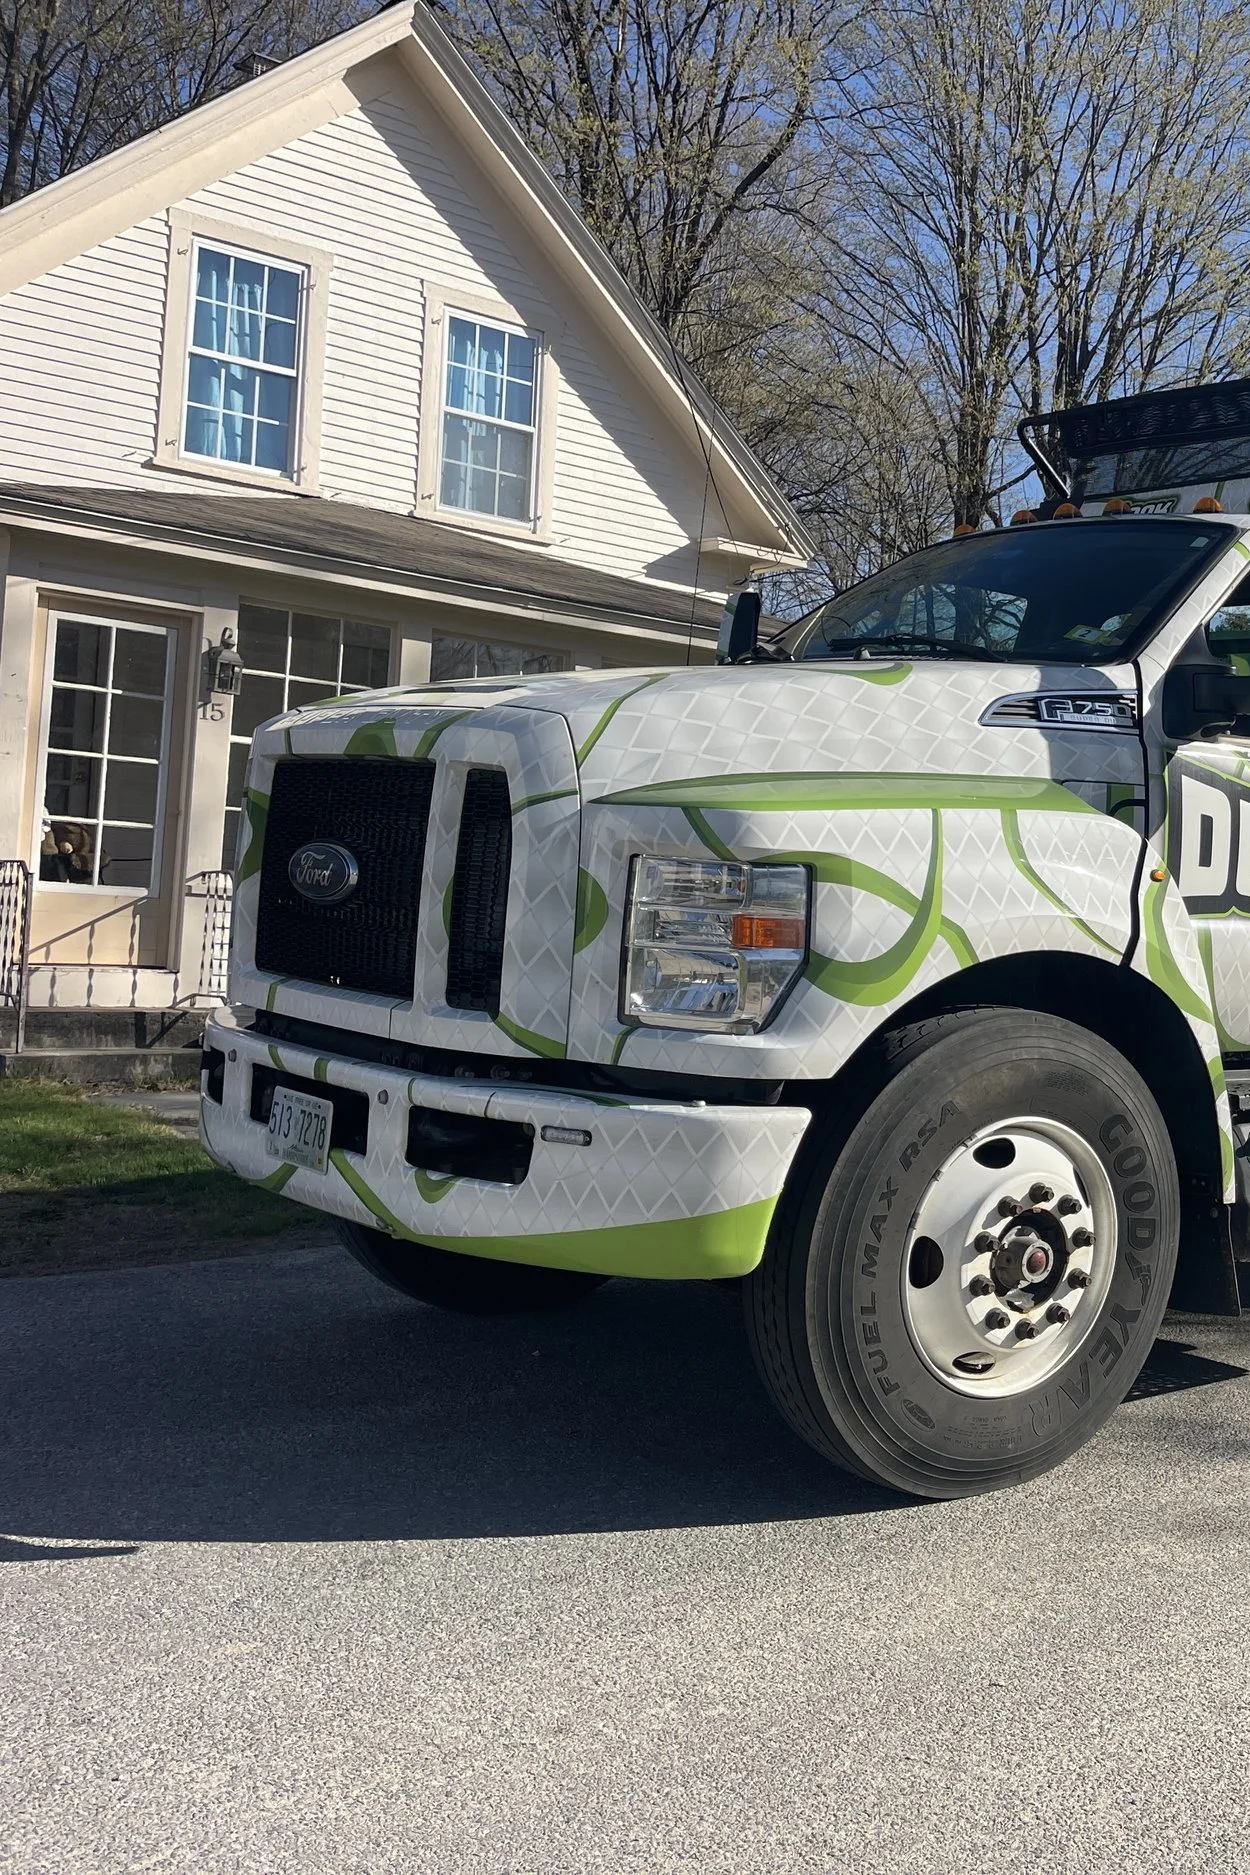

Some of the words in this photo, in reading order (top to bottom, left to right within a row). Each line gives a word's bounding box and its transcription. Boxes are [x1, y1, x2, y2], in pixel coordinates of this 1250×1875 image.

[1078, 629, 1091, 638] 2
[199, 702, 225, 722] 15
[296, 850, 334, 888] Ford
[269, 1101, 292, 1139] 513
[298, 1109, 327, 1150] 7278
[899, 1099, 961, 1173] RSA
[861, 1176, 899, 1279] MAX
[861, 1290, 901, 1397] FUEL
